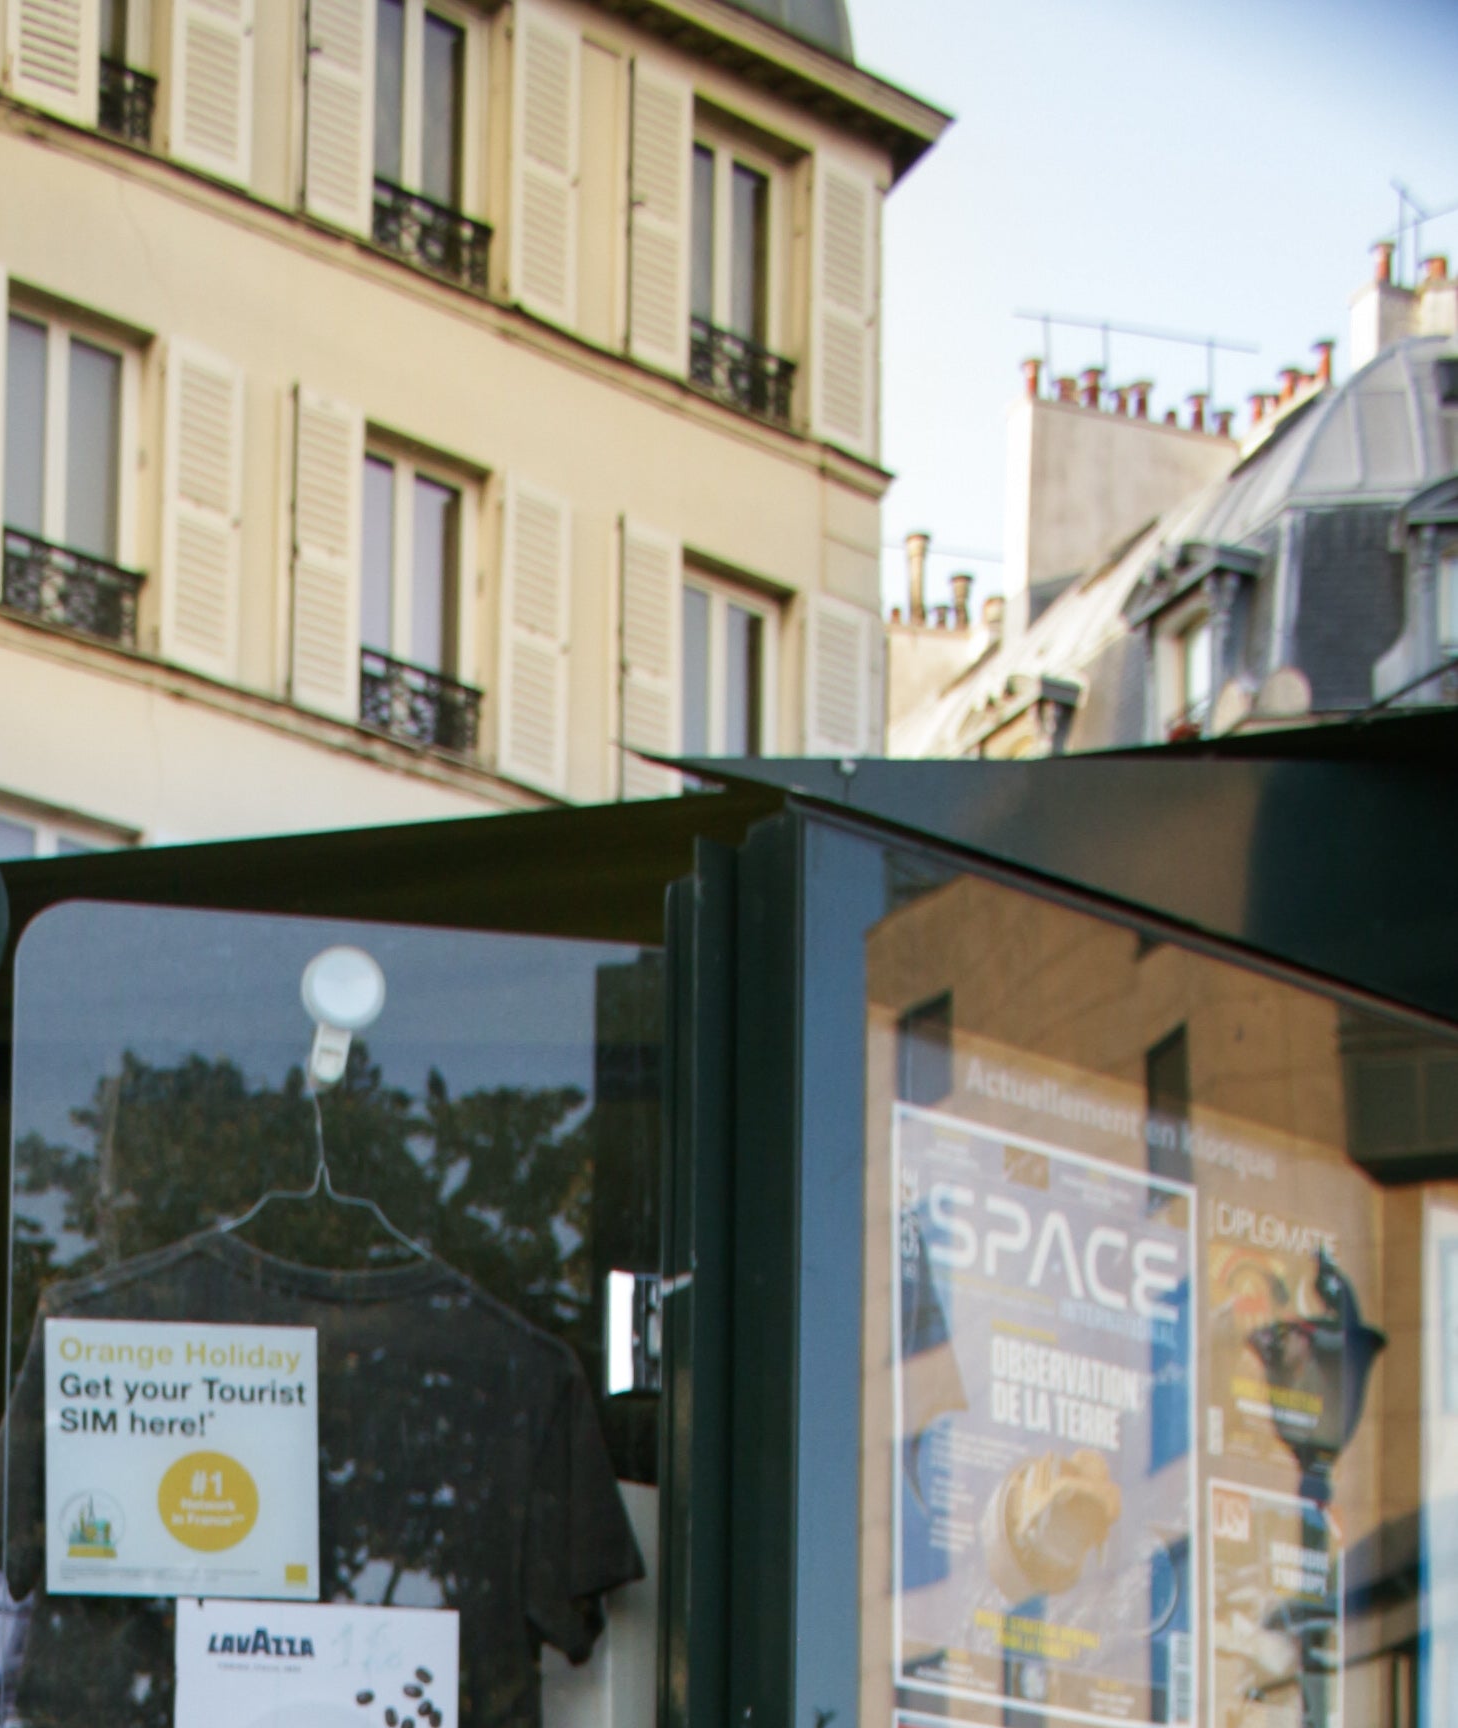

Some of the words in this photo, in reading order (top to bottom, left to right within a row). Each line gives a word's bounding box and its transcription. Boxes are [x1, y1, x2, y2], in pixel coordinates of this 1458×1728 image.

[966, 1058, 1141, 1135] Actuellement
[1146, 1114, 1177, 1147] en
[1183, 1120, 1278, 1182] kiosque
[927, 1180, 1179, 1323] SPACE
[58, 1337, 174, 1370] Orange
[185, 1341, 301, 1374] Holiday
[59, 1372, 113, 1400] Get
[124, 1379, 192, 1405] your
[202, 1376, 307, 1406] Tourist
[59, 1408, 118, 1433] SIM
[991, 1380, 1022, 1427] DE
[1024, 1386, 1052, 1434] LA
[1054, 1395, 1122, 1452] TERRE
[190, 1469, 224, 1498] #1
[207, 1626, 316, 1659] LAVAZZA
